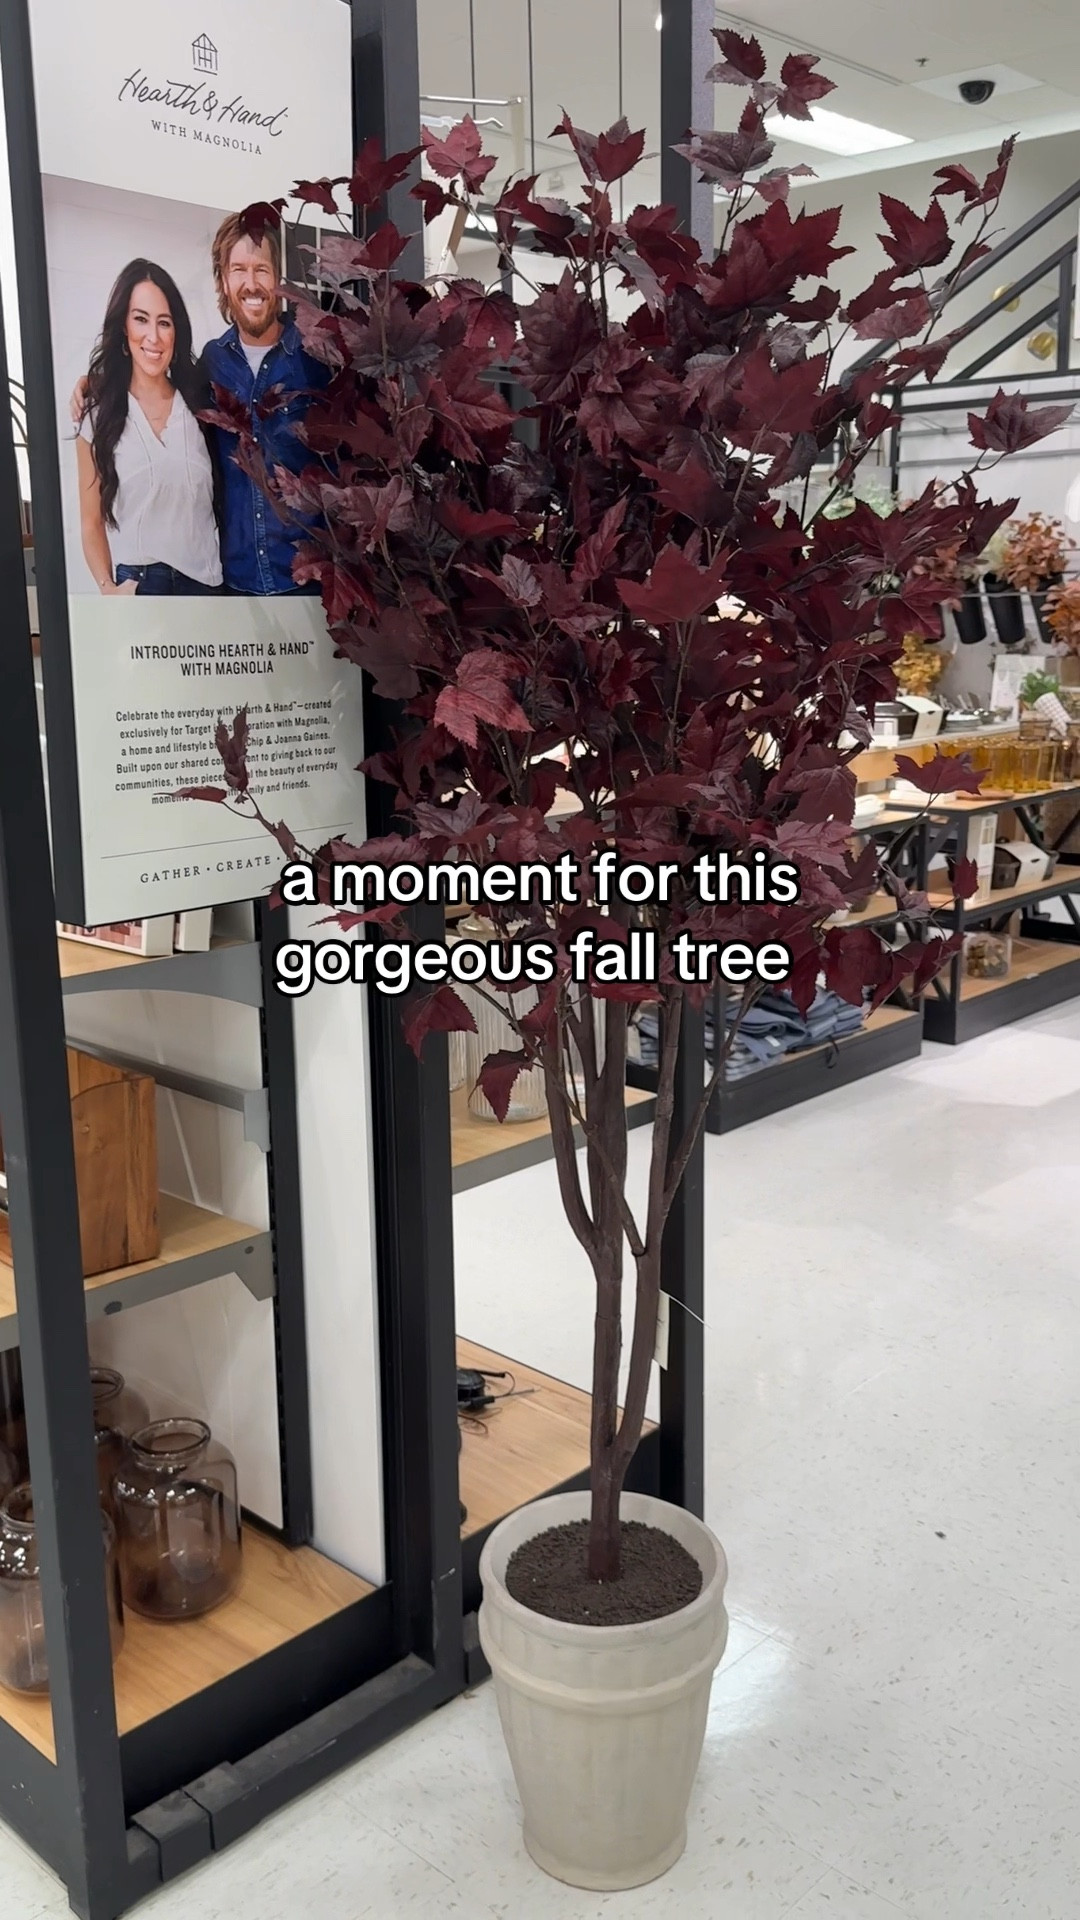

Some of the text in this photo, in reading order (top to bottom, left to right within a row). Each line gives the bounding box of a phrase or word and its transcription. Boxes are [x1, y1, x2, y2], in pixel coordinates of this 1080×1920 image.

[118, 68, 206, 115] Hearth
[202, 90, 218, 121] &
[151, 119, 262, 155] WITH MAGNOLIA
[130, 644, 215, 659] INTRODUCING
[218, 643, 264, 658] HEARTH
[267, 642, 277, 656] &
[180, 660, 274, 676] WITH MAGNOLIA
[115, 710, 159, 722] Celebrate
[160, 709, 175, 719] the
[177, 706, 214, 719] everyday
[216, 705, 234, 716] with
[235, 704, 263, 715] Harth
[265, 703, 272, 713] &
[119, 727, 168, 739] exclusively
[170, 725, 183, 736] for
[185, 724, 211, 736] Target
[276, 718, 293, 728] with
[294, 716, 330, 728] Magnolia,
[120, 748, 127, 756] a
[129, 745, 153, 756] home
[155, 743, 171, 754] and
[173, 740, 207, 752] lifestyle
[247, 736, 264, 747] Chip
[265, 735, 273, 745] &
[274, 734, 302, 744] Joanna
[303, 731, 330, 742] Gaines.
[116, 762, 138, 774] Built
[140, 763, 162, 773] upon
[164, 761, 178, 770] our
[180, 756, 209, 768] shared
[261, 753, 269, 761] to
[271, 750, 294, 762] giving
[295, 748, 313, 758] back
[314, 747, 322, 756] to
[324, 746, 336, 755] our
[115, 777, 173, 791] communities,
[175, 775, 199, 786] these
[255, 768, 268, 778] the
[269, 766, 295, 777] beauty
[296, 764, 305, 773] of
[306, 761, 338, 773] everyday
[266, 782, 281, 792] and
[282, 779, 311, 791] friends.
[140, 855, 271, 884] GATHER CREATE
